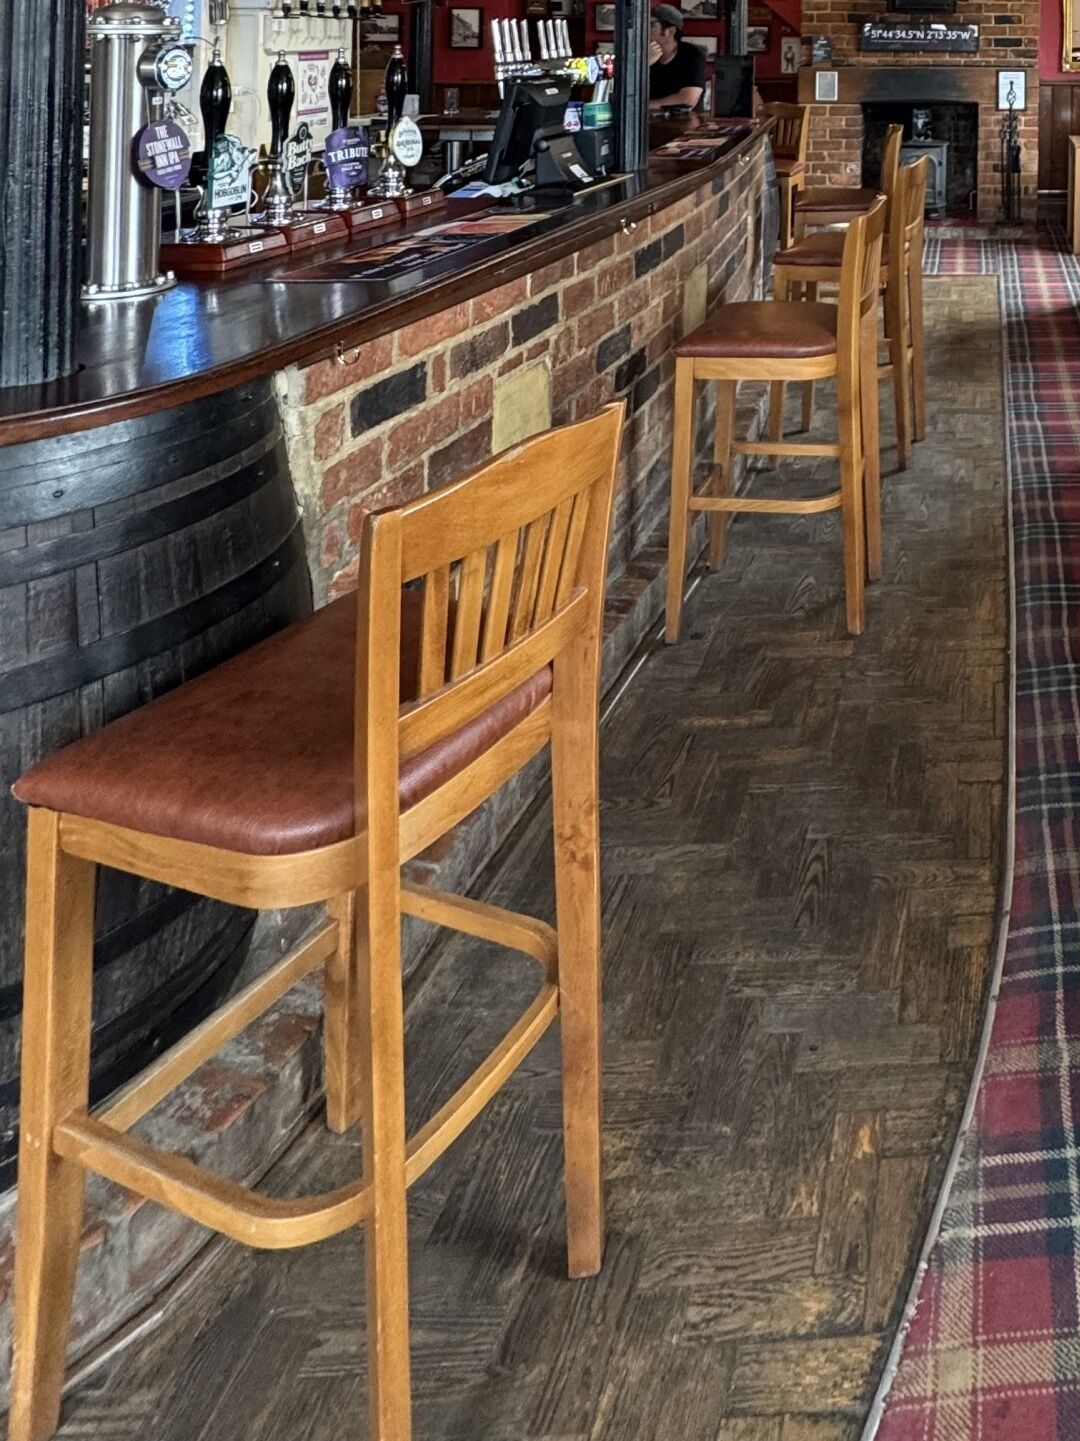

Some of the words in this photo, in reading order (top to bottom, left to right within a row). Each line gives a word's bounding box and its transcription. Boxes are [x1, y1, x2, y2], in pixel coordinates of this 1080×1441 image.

[154, 125, 169, 140] THE
[145, 135, 184, 157] STONEWALL
[287, 138, 313, 157] Butty
[327, 146, 369, 163] TRIBUTE
[167, 150, 181, 165] IPA
[287, 149, 311, 171] Bach
[214, 183, 247, 199] HOBGOBLIN
